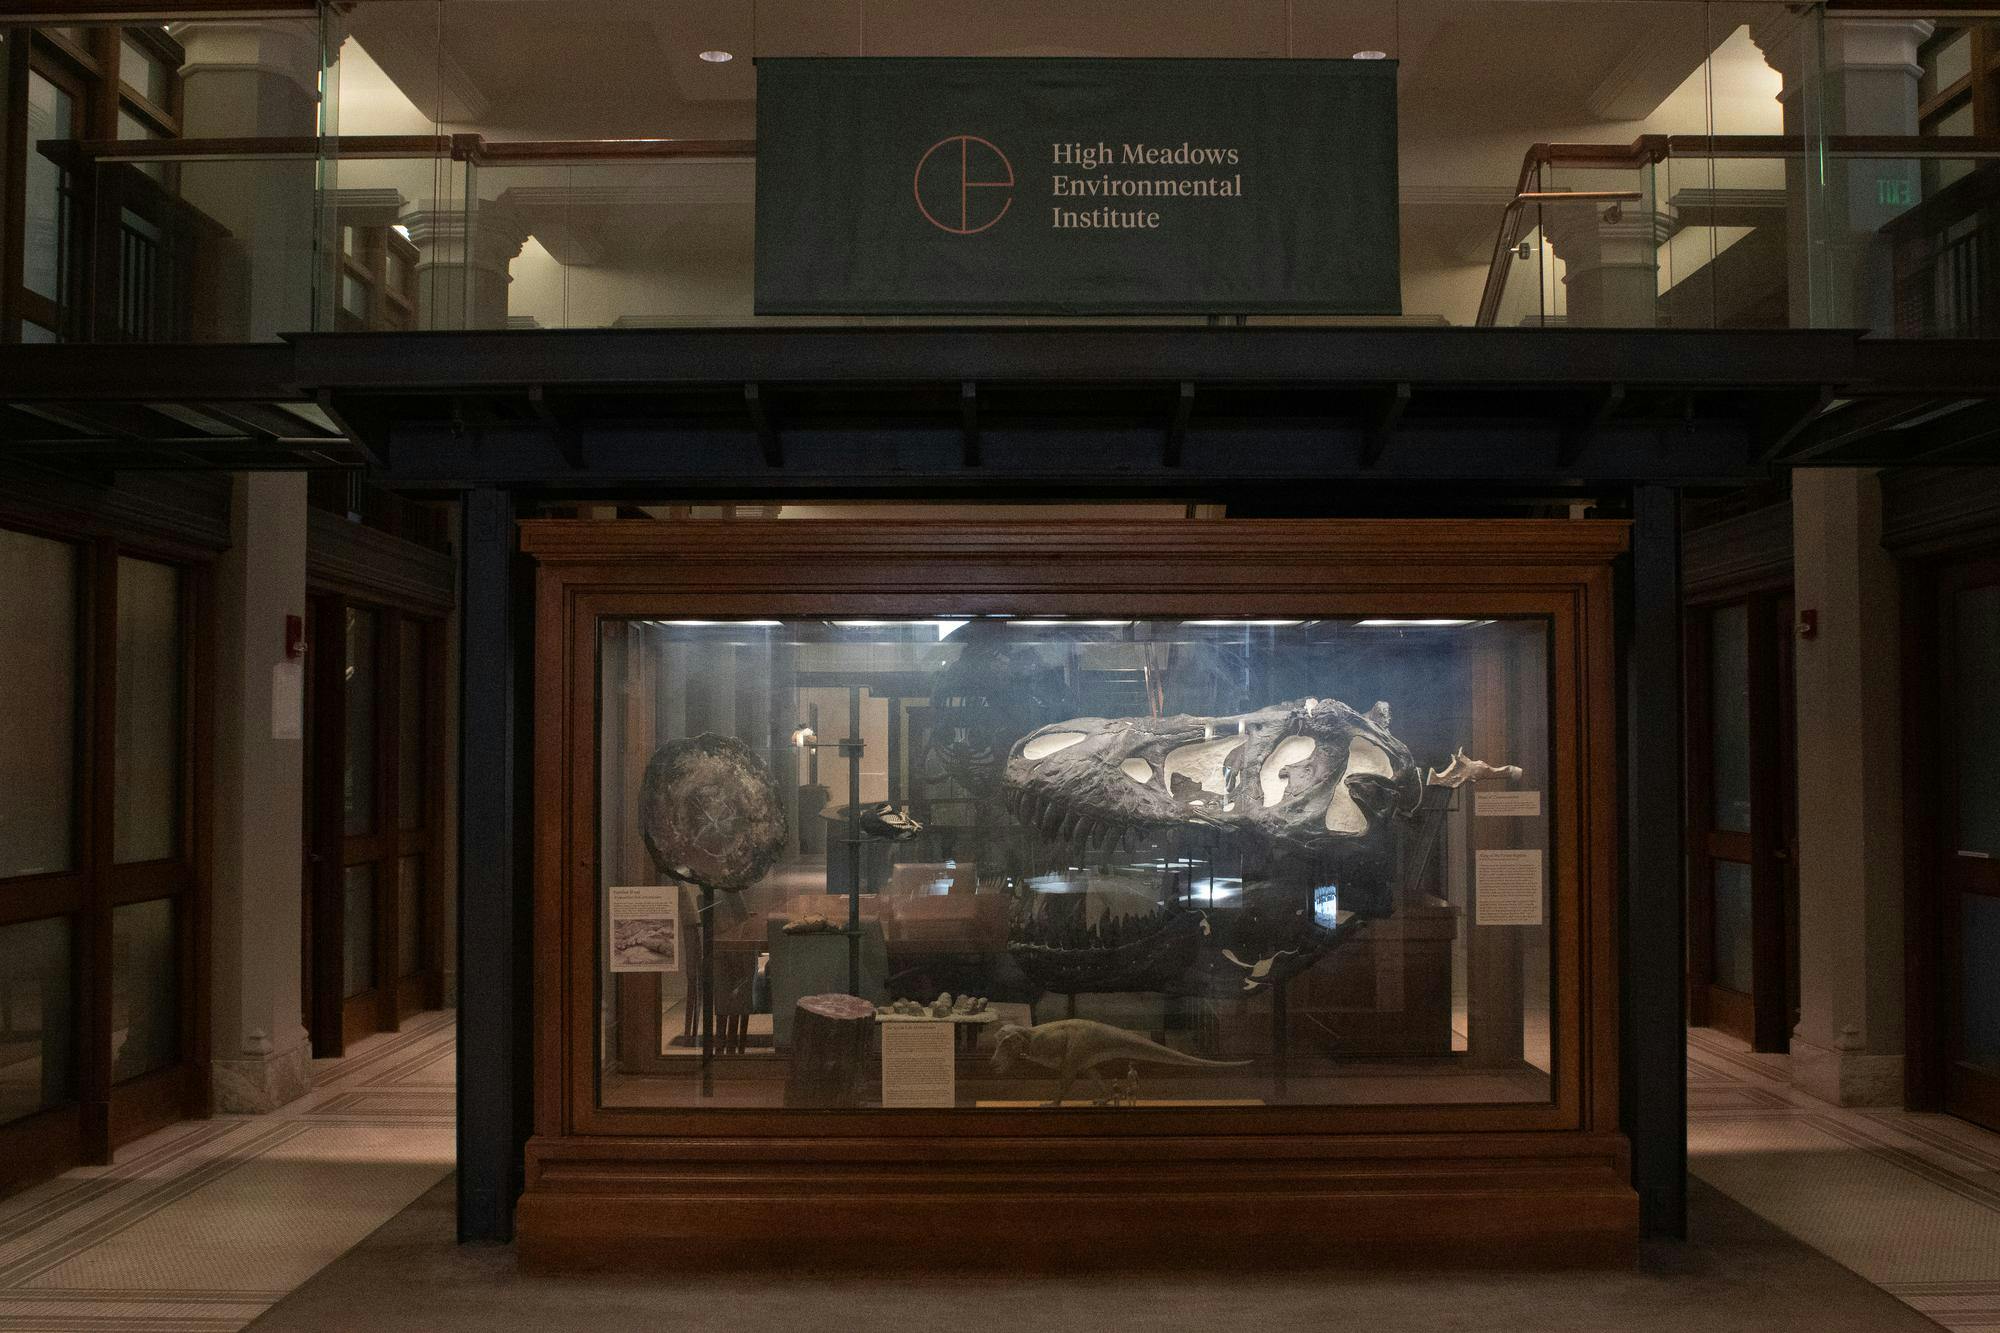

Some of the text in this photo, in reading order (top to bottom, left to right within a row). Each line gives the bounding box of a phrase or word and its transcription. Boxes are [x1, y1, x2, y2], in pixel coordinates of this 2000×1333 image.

[1052, 142, 1240, 170] High Meadows
[1052, 174, 1242, 198] Environmental
[1052, 206, 1161, 229] Institute
